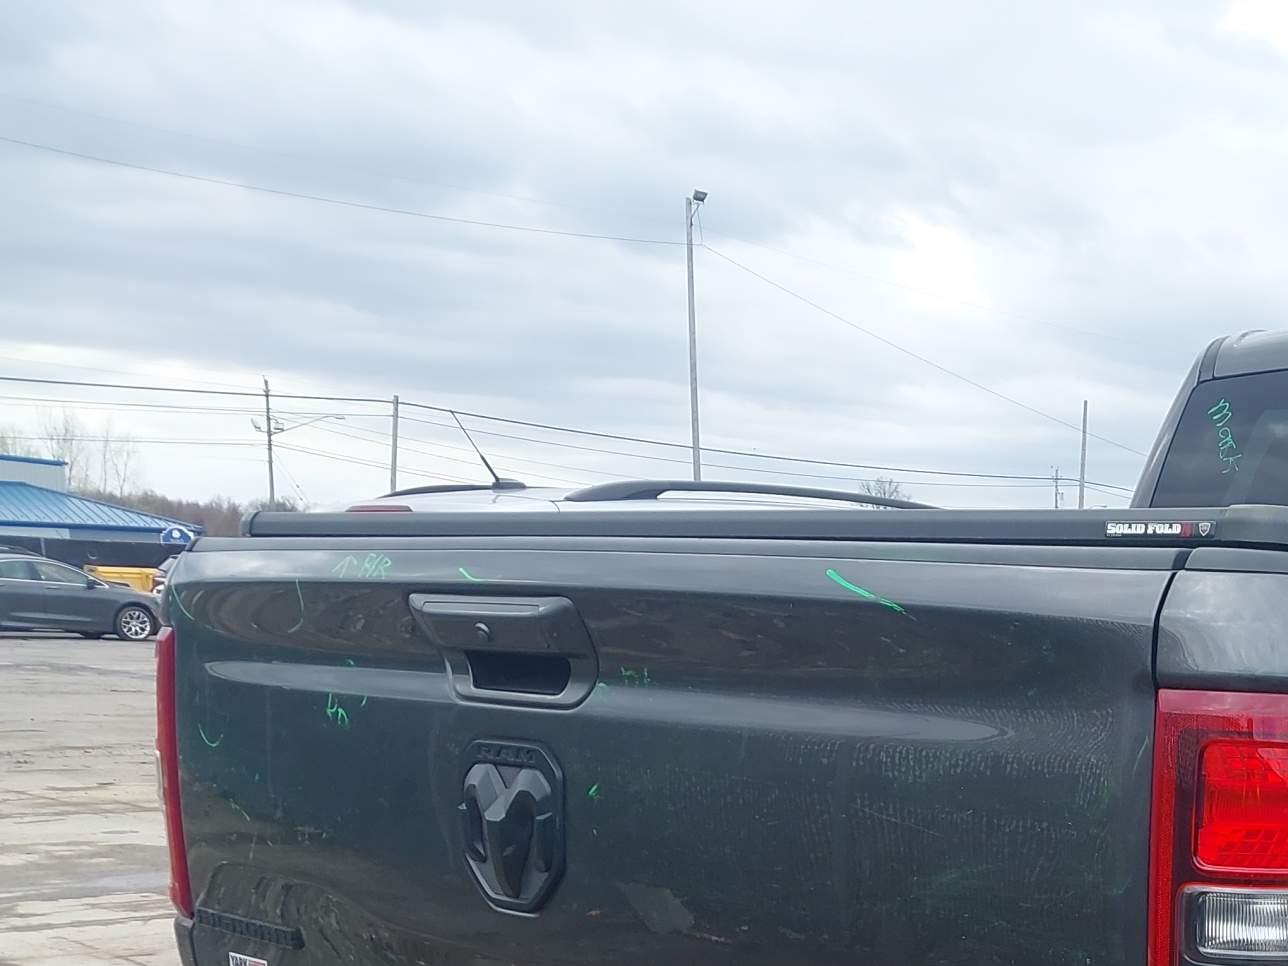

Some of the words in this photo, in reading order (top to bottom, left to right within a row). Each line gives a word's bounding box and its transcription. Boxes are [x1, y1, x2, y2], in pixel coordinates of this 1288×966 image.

[1106, 522, 1146, 535] SOLID
[1146, 522, 1182, 535] FOLD
[476, 744, 537, 764] RAM
